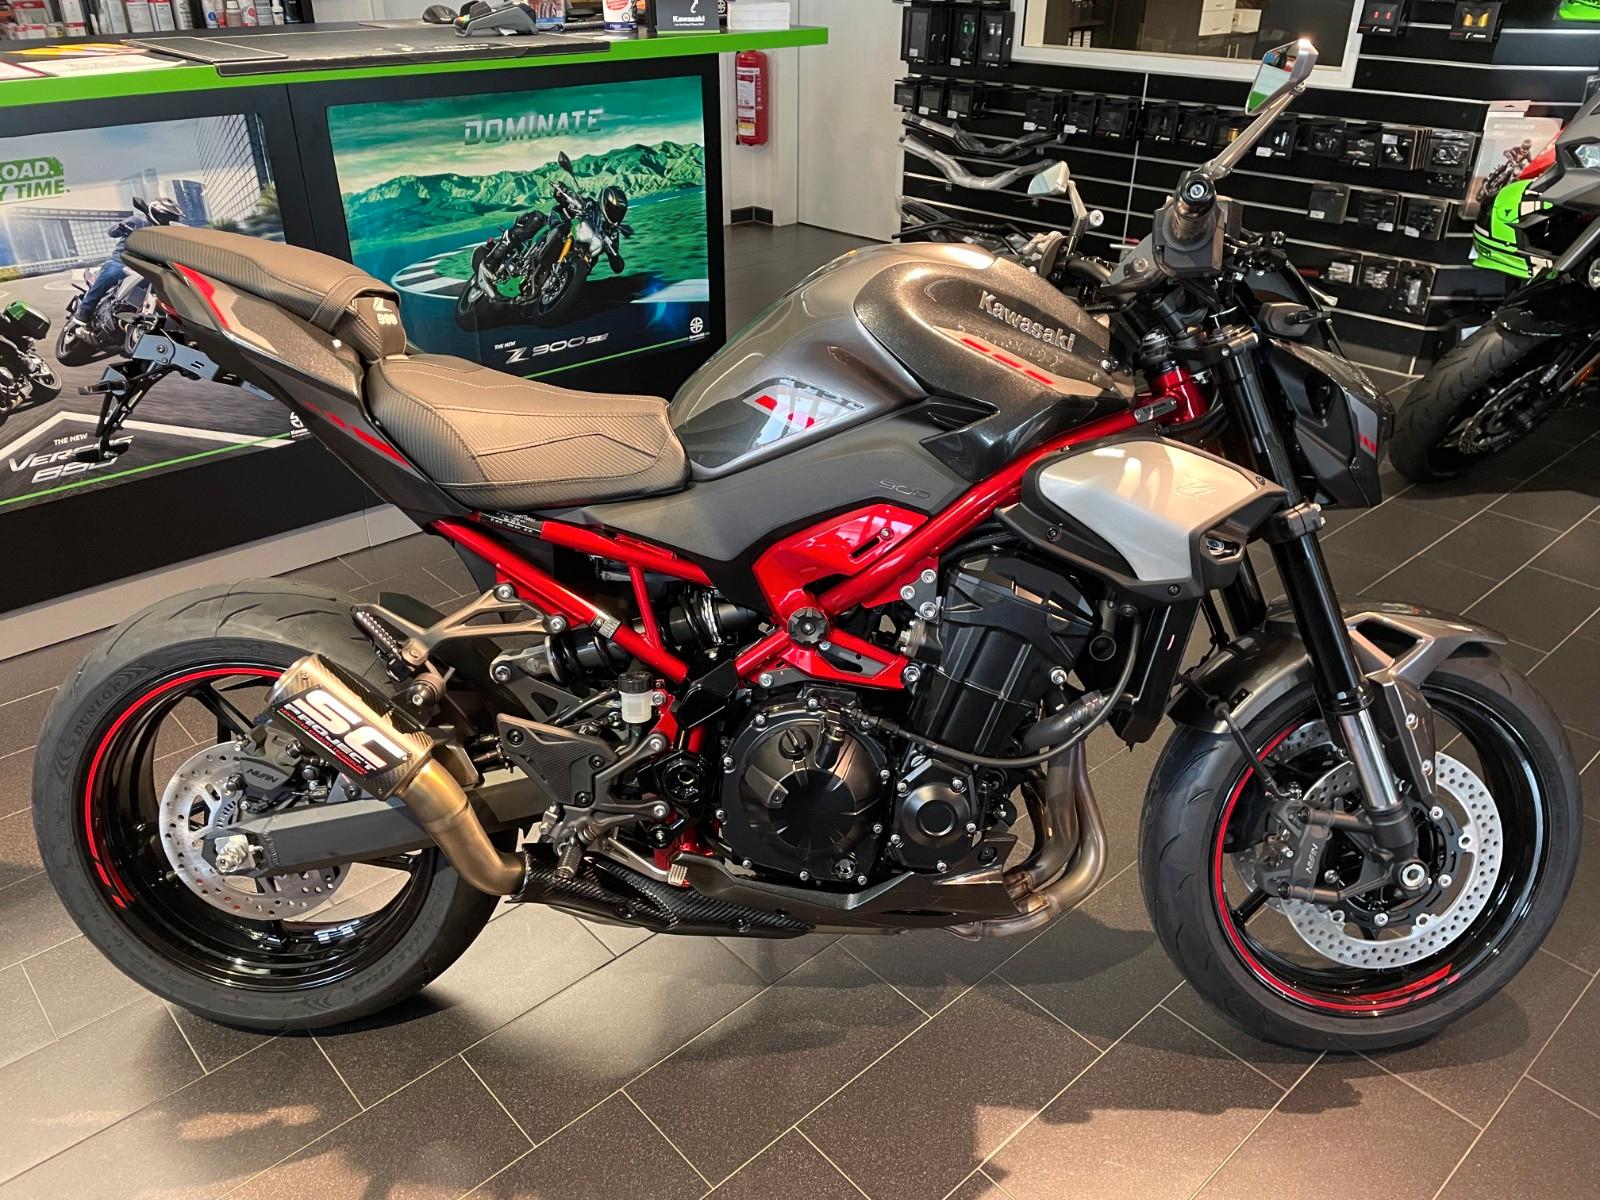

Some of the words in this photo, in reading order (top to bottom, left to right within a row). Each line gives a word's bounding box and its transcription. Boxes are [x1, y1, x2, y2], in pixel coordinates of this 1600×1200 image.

[464, 108, 603, 145] DOMINATE
[0, 161, 54, 180] OAD.
[14, 178, 71, 199] TIME.
[377, 313, 398, 325] 900
[979, 289, 1076, 352] Kawasaki
[53, 438, 68, 446] THE
[70, 433, 88, 442] NEW
[284, 703, 377, 771] PROJECT
[292, 689, 408, 769] SC
